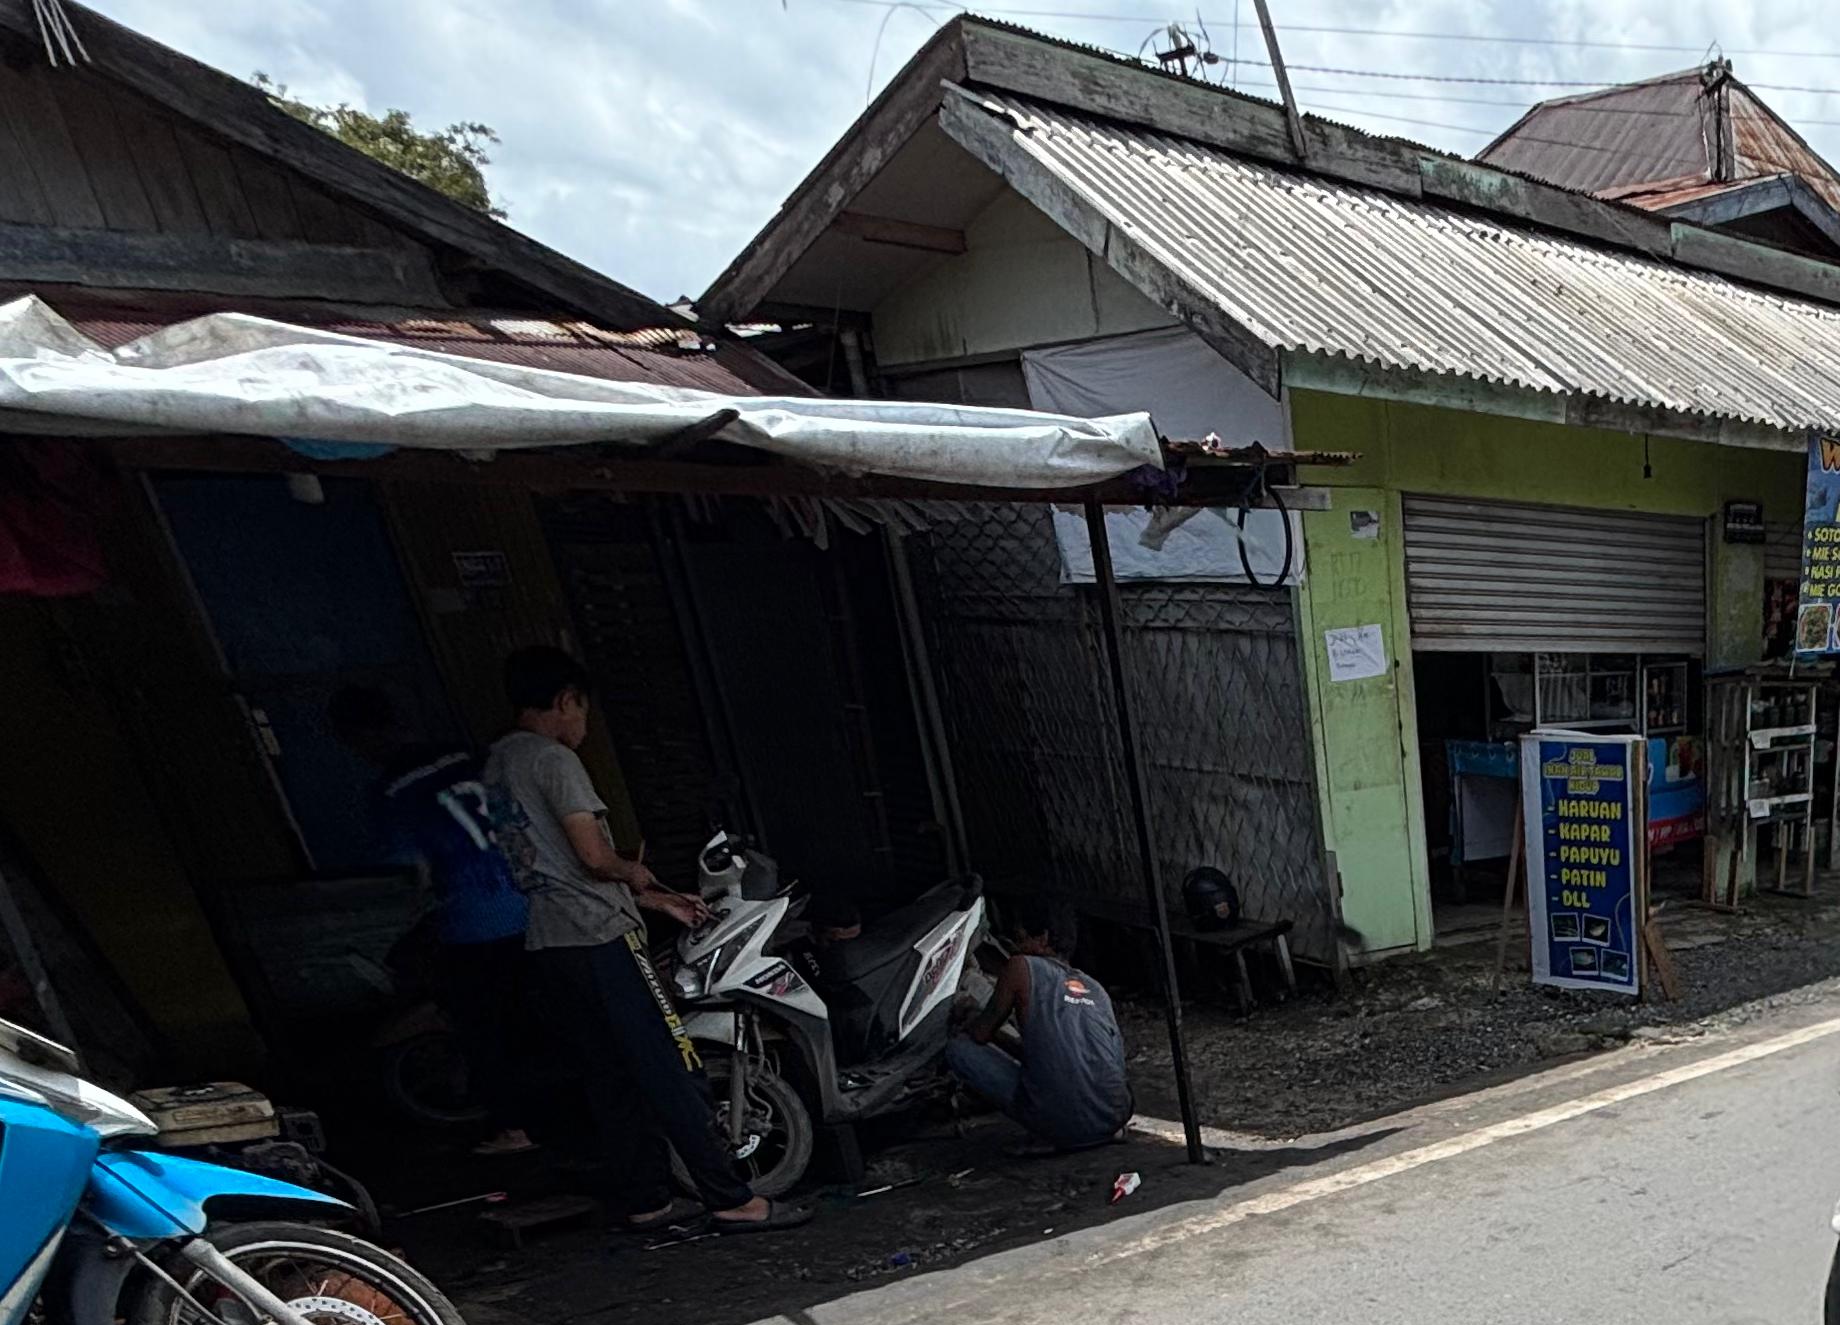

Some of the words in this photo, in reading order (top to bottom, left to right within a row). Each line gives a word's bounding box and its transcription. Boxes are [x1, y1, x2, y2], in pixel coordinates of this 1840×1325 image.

[1812, 546, 1830, 560] MIE
[1811, 565, 1834, 578] NASI
[1809, 583, 1826, 597] MIE
[1558, 799, 1622, 820] HARUAN
[1559, 822, 1611, 842] KAPAR
[1560, 845, 1621, 866] PAPUYU
[1561, 867, 1606, 888] PATIN
[1562, 889, 1591, 909] DLL
